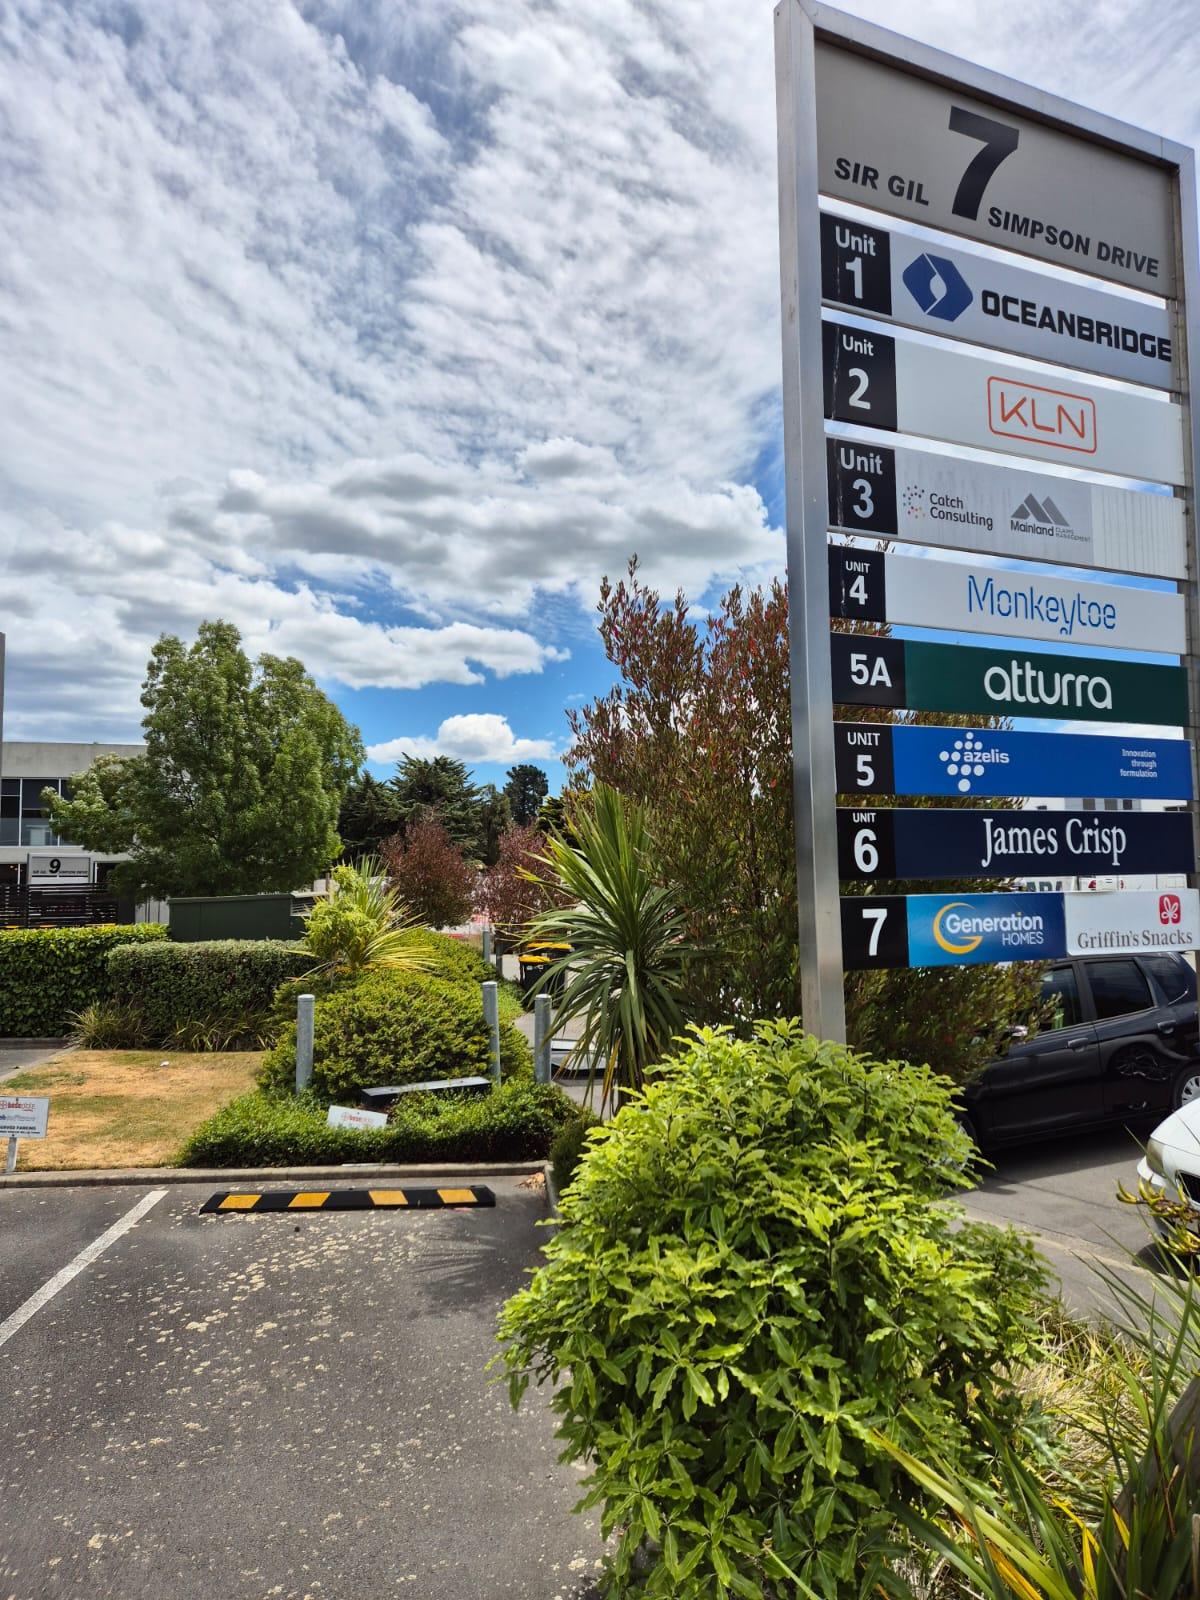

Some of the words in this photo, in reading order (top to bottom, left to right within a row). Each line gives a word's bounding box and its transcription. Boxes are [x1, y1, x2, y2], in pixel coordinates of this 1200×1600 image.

[948, 105, 1020, 220] 7
[834, 157, 878, 190] SIR
[887, 174, 929, 206] GIL
[987, 206, 1090, 256] SIMPSON
[1096, 241, 1159, 278] DRIVE
[834, 225, 877, 257] Unit
[844, 256, 865, 300] 1
[981, 290, 1172, 362] OCEANBRIDGE
[842, 334, 875, 357] Unit
[848, 367, 871, 411] 2
[1000, 391, 1086, 439] KLN
[840, 448, 884, 476] Unit
[852, 478, 875, 519] 3
[929, 493, 964, 510] Catch
[929, 506, 994, 532] Consulting
[1010, 519, 1054, 537] Mainland
[845, 561, 870, 573] UNIT
[849, 575, 868, 605] 4
[967, 575, 1117, 636] Monkeytoe
[850, 653, 892, 687] 5A
[983, 659, 1113, 710] atturra
[847, 732, 881, 747] UNIT
[855, 754, 875, 787] 5
[963, 748, 1010, 764] azelis
[852, 812, 876, 824] UNIT
[853, 828, 879, 873] 6
[981, 818, 1058, 868] James
[1065, 817, 1127, 866] Crisp
[49, 858, 61, 874] 9
[862, 908, 888, 957] 7
[945, 911, 1044, 934] Generation
[1002, 931, 1044, 946] HOMES
[1141, 929, 1193, 947] Snacks
